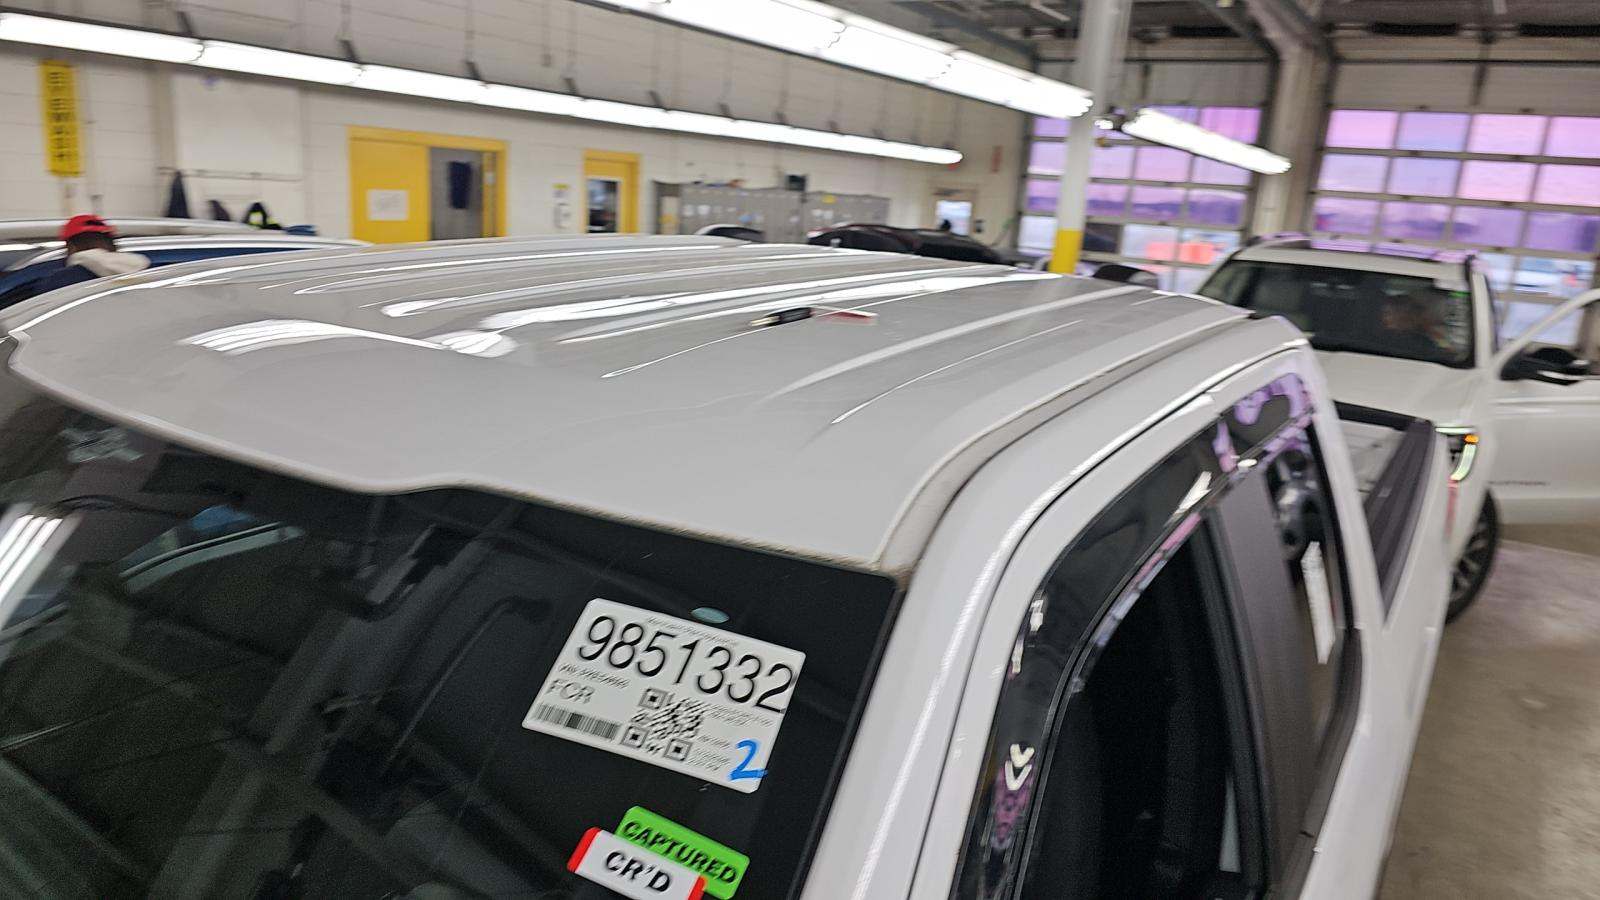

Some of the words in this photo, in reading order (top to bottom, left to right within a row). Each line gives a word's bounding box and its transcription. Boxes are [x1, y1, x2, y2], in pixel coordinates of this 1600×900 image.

[579, 615, 793, 714] 9851332
[546, 679, 595, 704] FCR
[729, 739, 768, 782] 2
[606, 851, 671, 893] CR'D
[623, 821, 737, 884] CAPTURED
